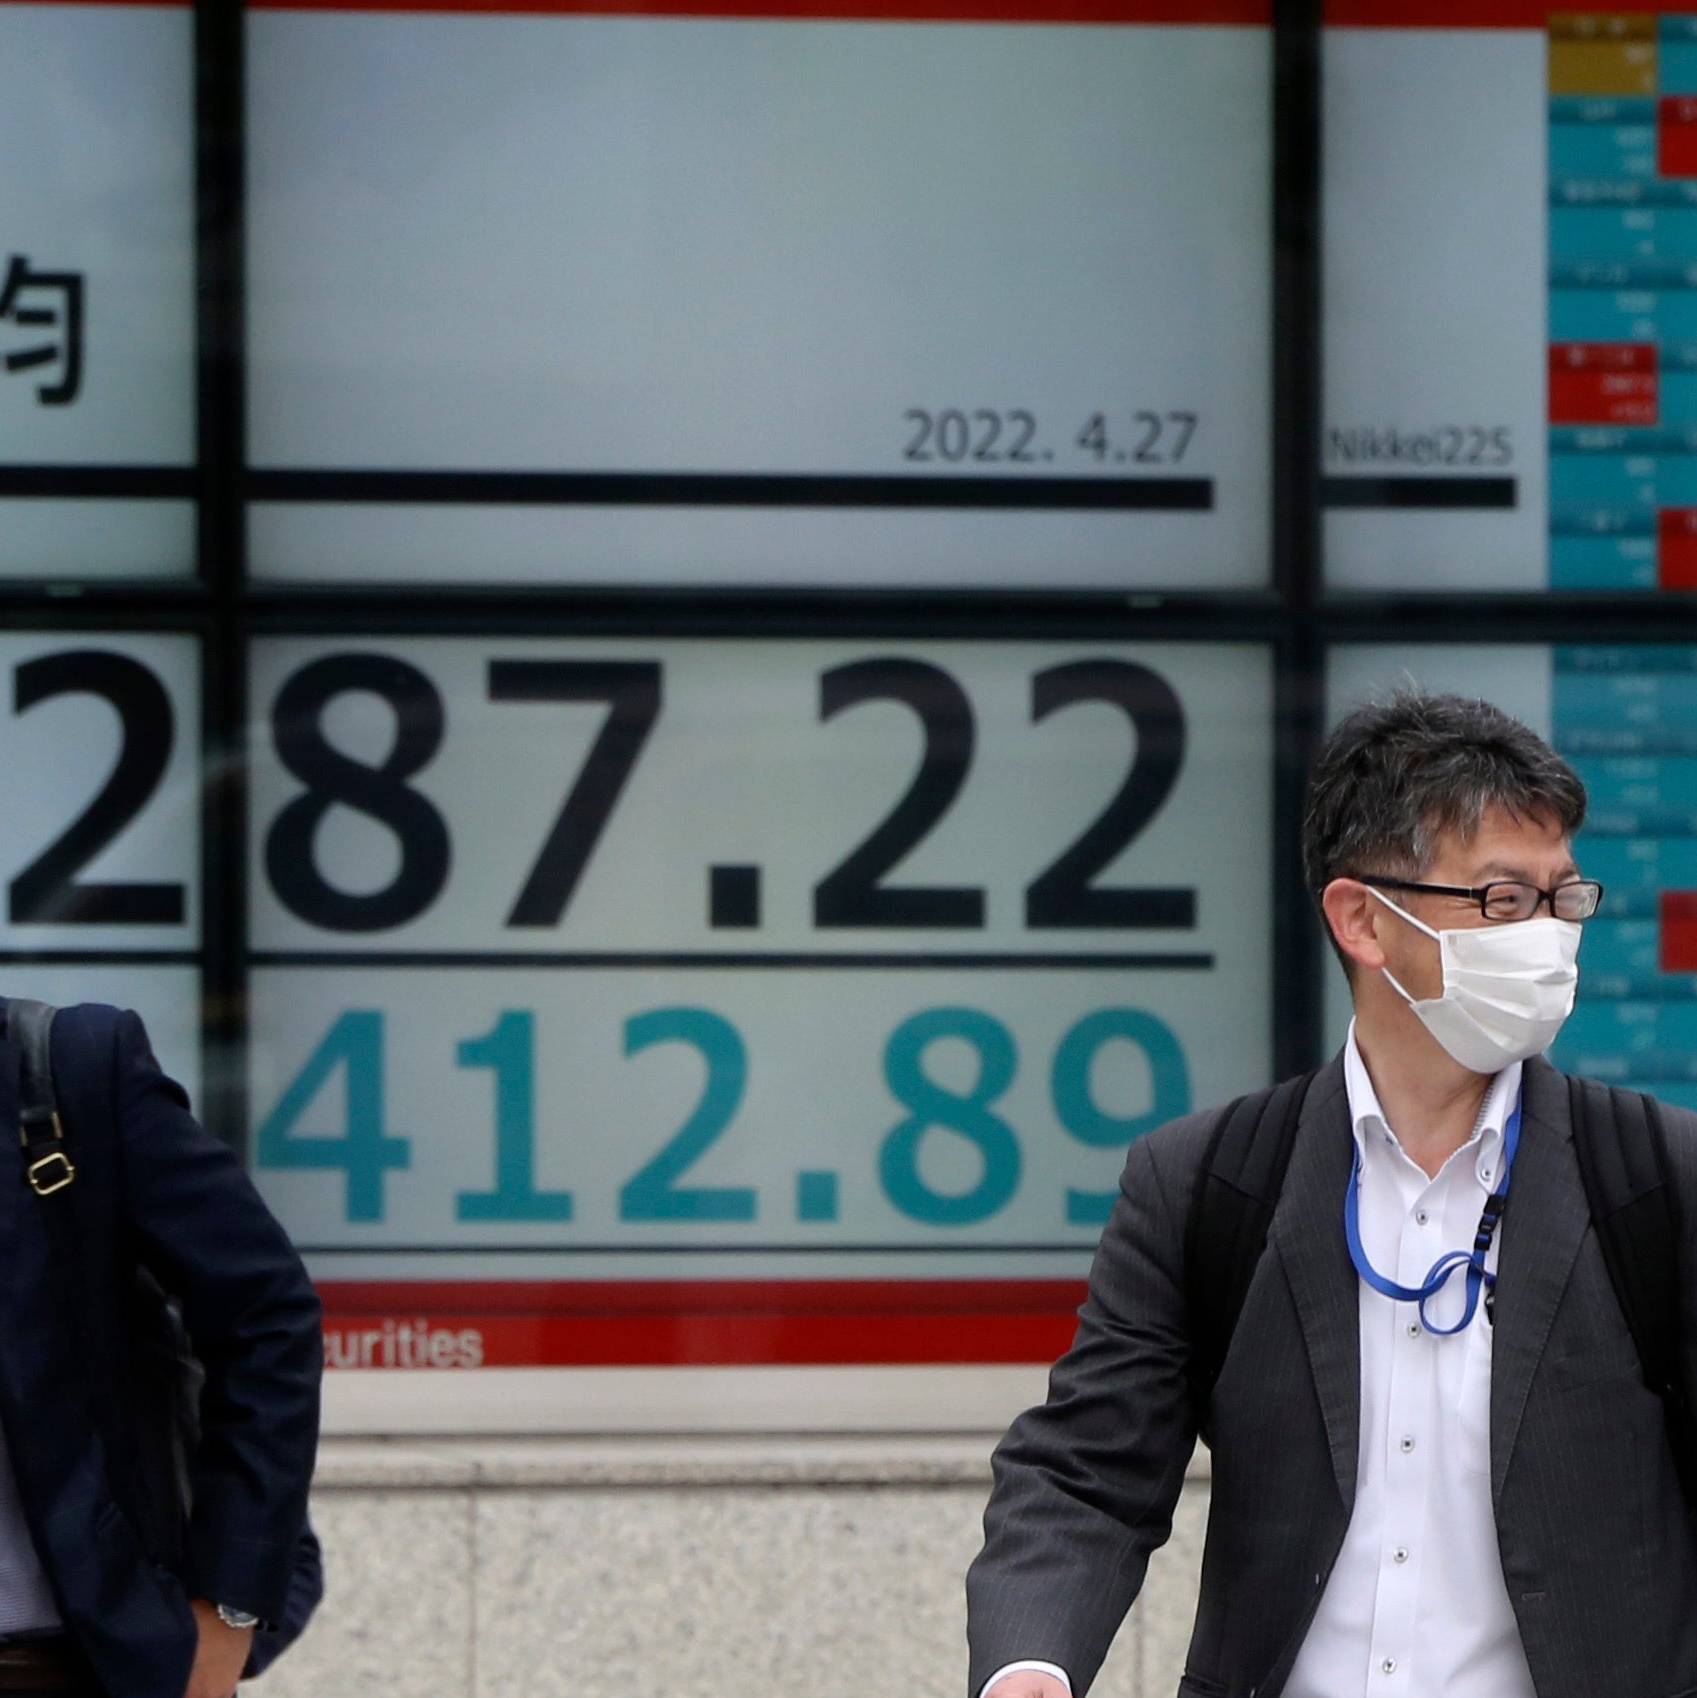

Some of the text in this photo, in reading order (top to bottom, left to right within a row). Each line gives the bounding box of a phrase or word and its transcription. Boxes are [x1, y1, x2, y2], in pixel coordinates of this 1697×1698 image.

[1078, 410, 1199, 464] 4.27
[1327, 425, 1513, 468] Nikkei225
[258, 1006, 1193, 1226] 412.89
